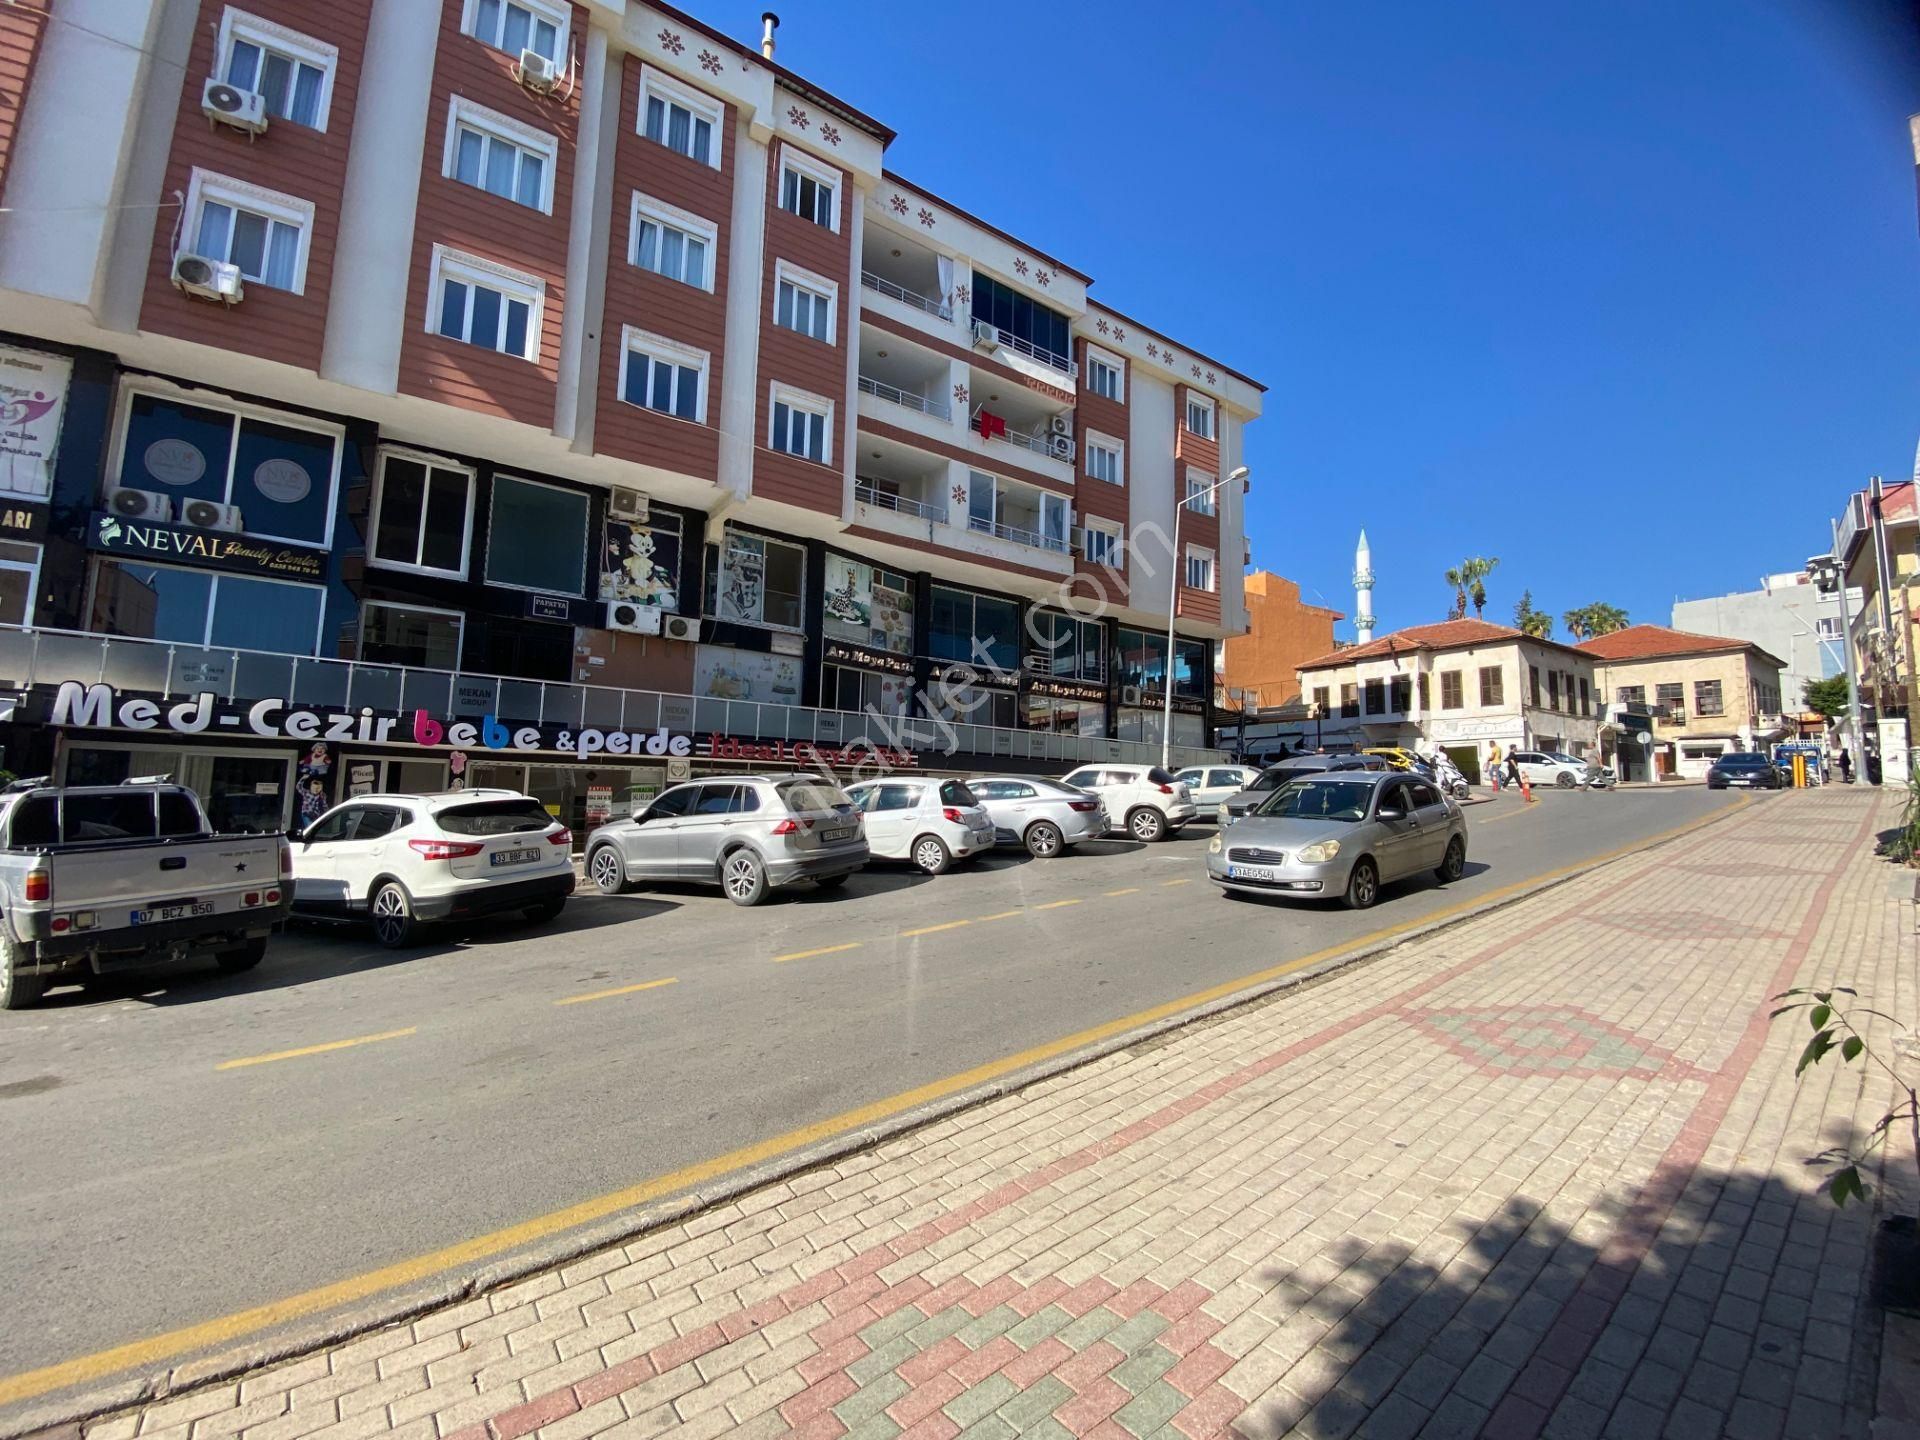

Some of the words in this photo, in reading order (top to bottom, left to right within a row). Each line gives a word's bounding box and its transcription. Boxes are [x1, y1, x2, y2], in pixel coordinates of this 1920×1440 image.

[124, 525, 225, 559] NEVAL
[224, 541, 274, 566] Beauty
[276, 550, 321, 568] Center
[458, 687, 492, 698] MEKAN
[460, 698, 487, 707] GROUP
[51, 681, 398, 742] Med-Cezir
[413, 709, 541, 751] bebe
[709, 732, 786, 761] İdeal
[496, 854, 506, 863] 33
[139, 911, 154, 922] 07
[162, 907, 184, 919] BCZ
[191, 903, 213, 915] 850
